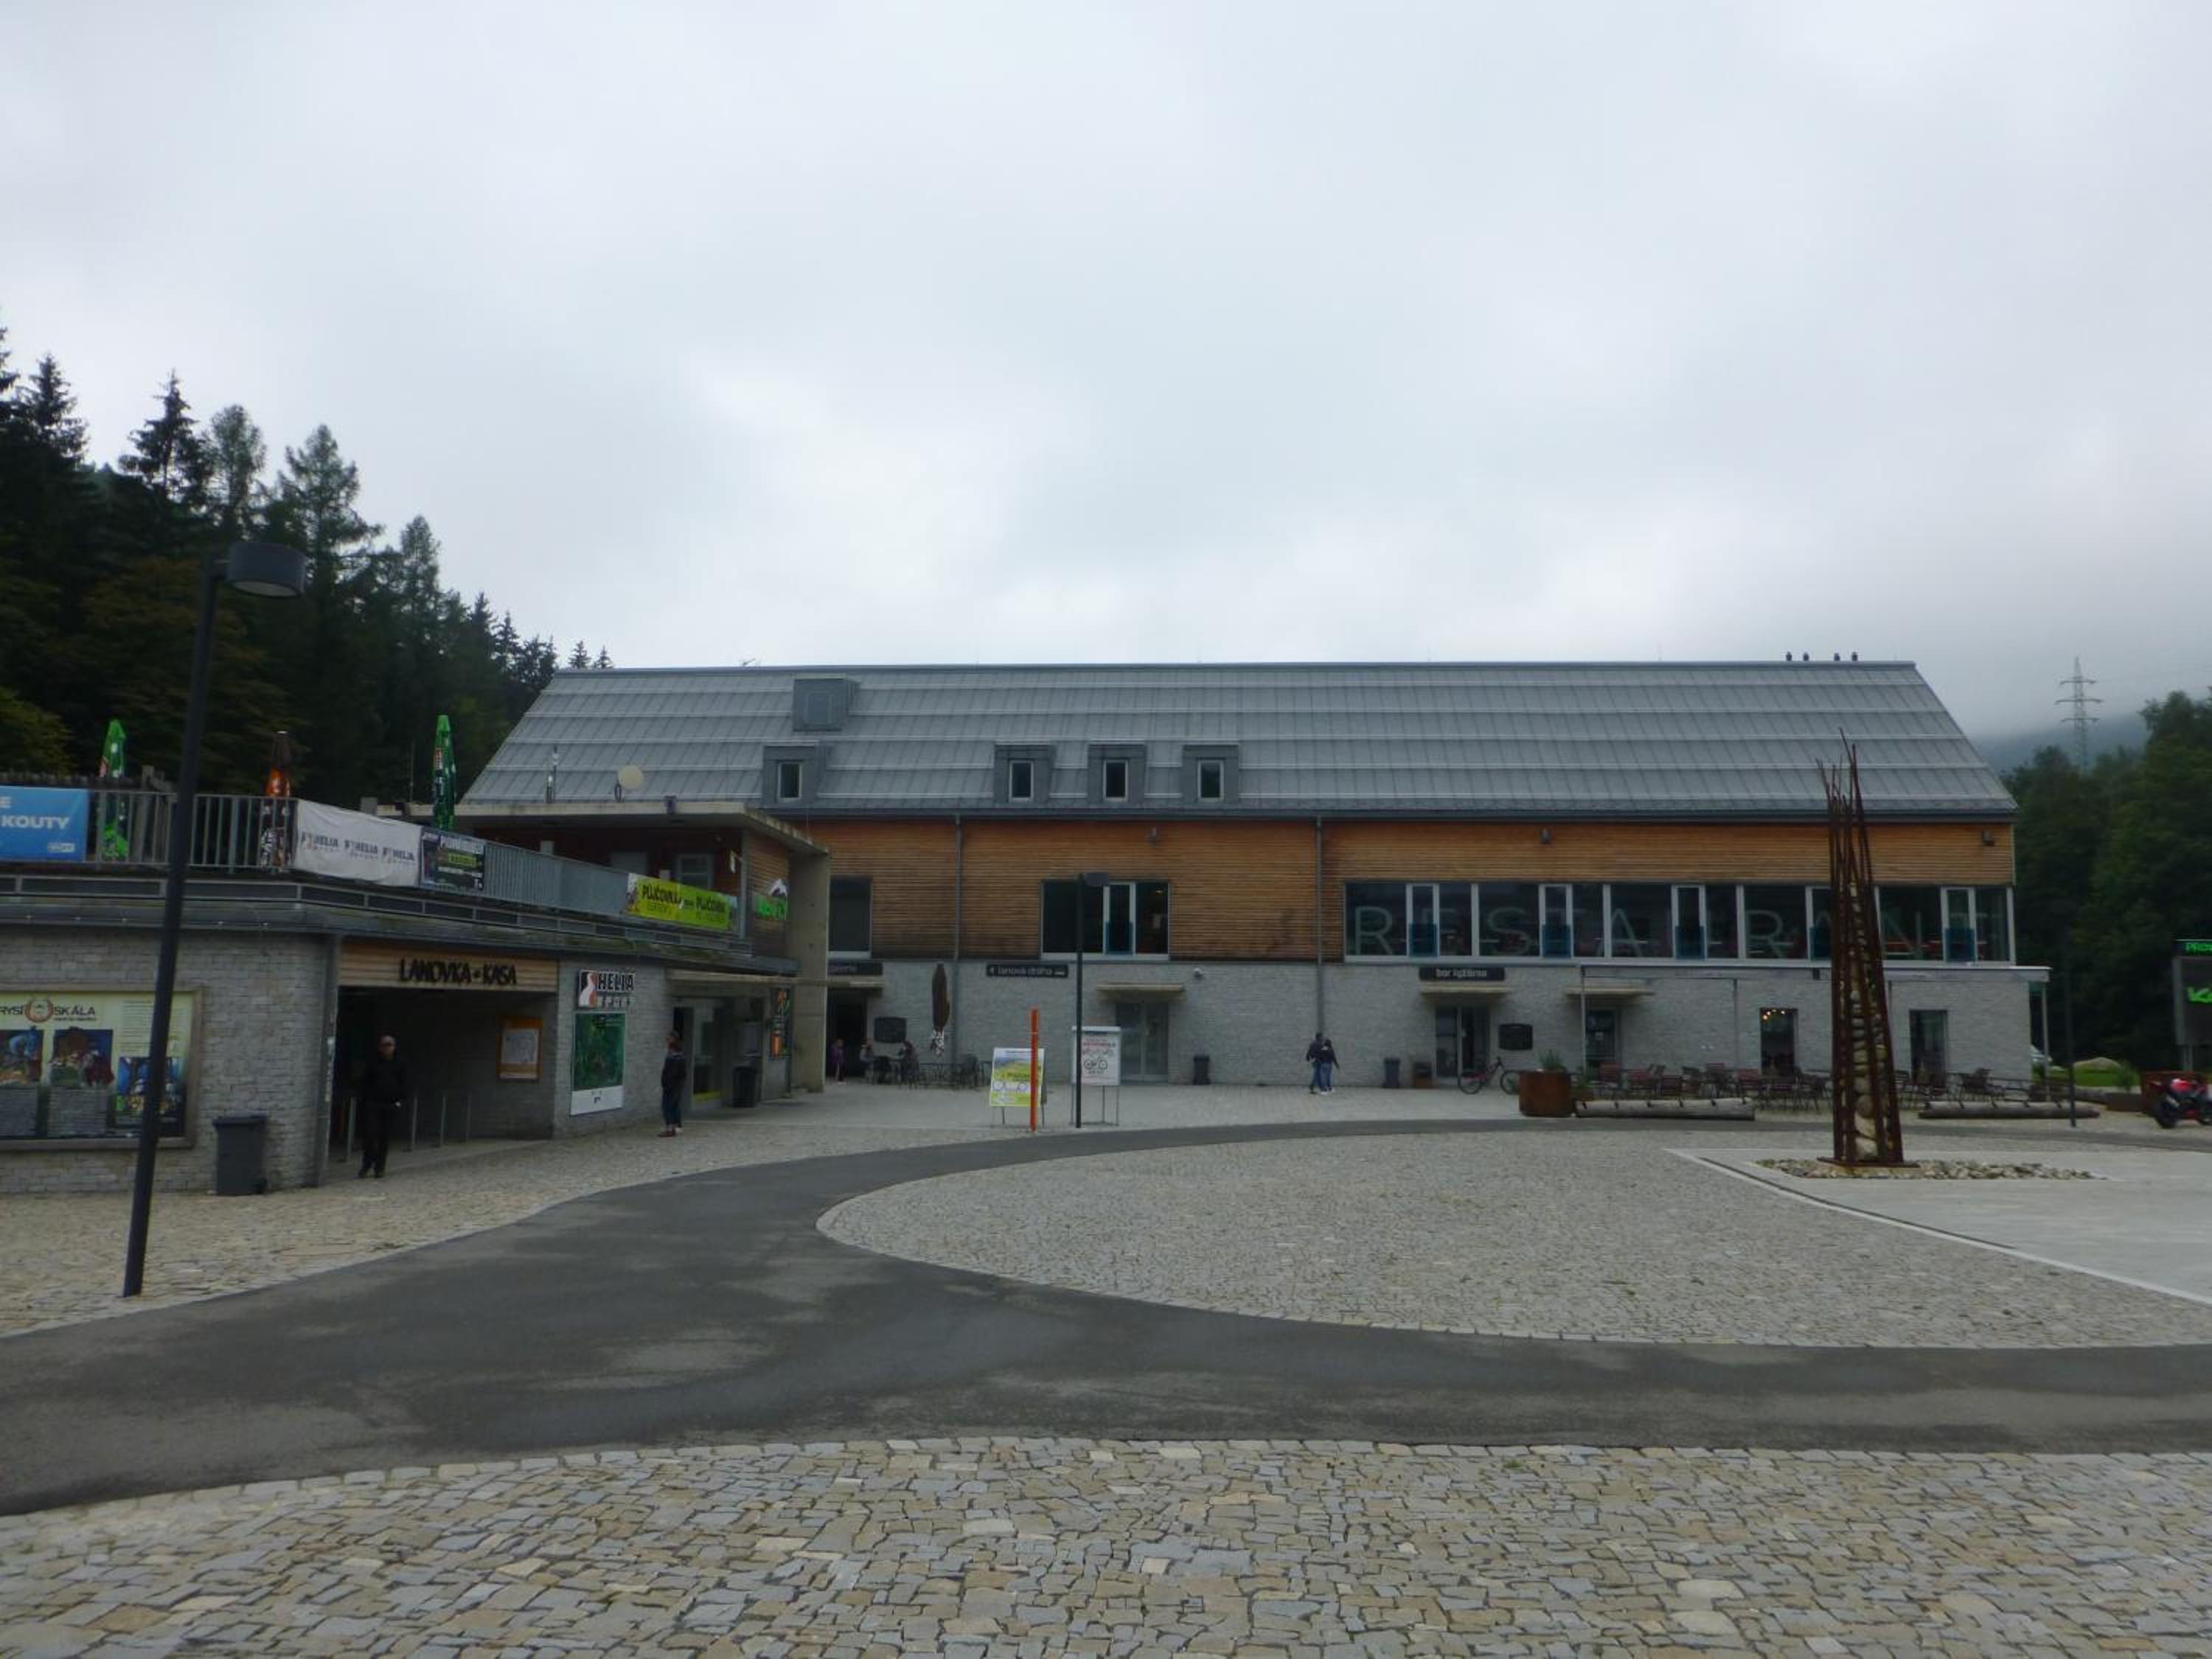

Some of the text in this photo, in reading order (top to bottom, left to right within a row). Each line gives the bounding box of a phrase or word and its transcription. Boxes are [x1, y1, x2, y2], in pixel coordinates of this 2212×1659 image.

[2, 815, 70, 829] KOUTY
[400, 959, 471, 984] LANOVKA
[483, 964, 515, 985] KASA
[597, 972, 636, 991] HELIA
[54, 1004, 96, 1015] SKÁLA
